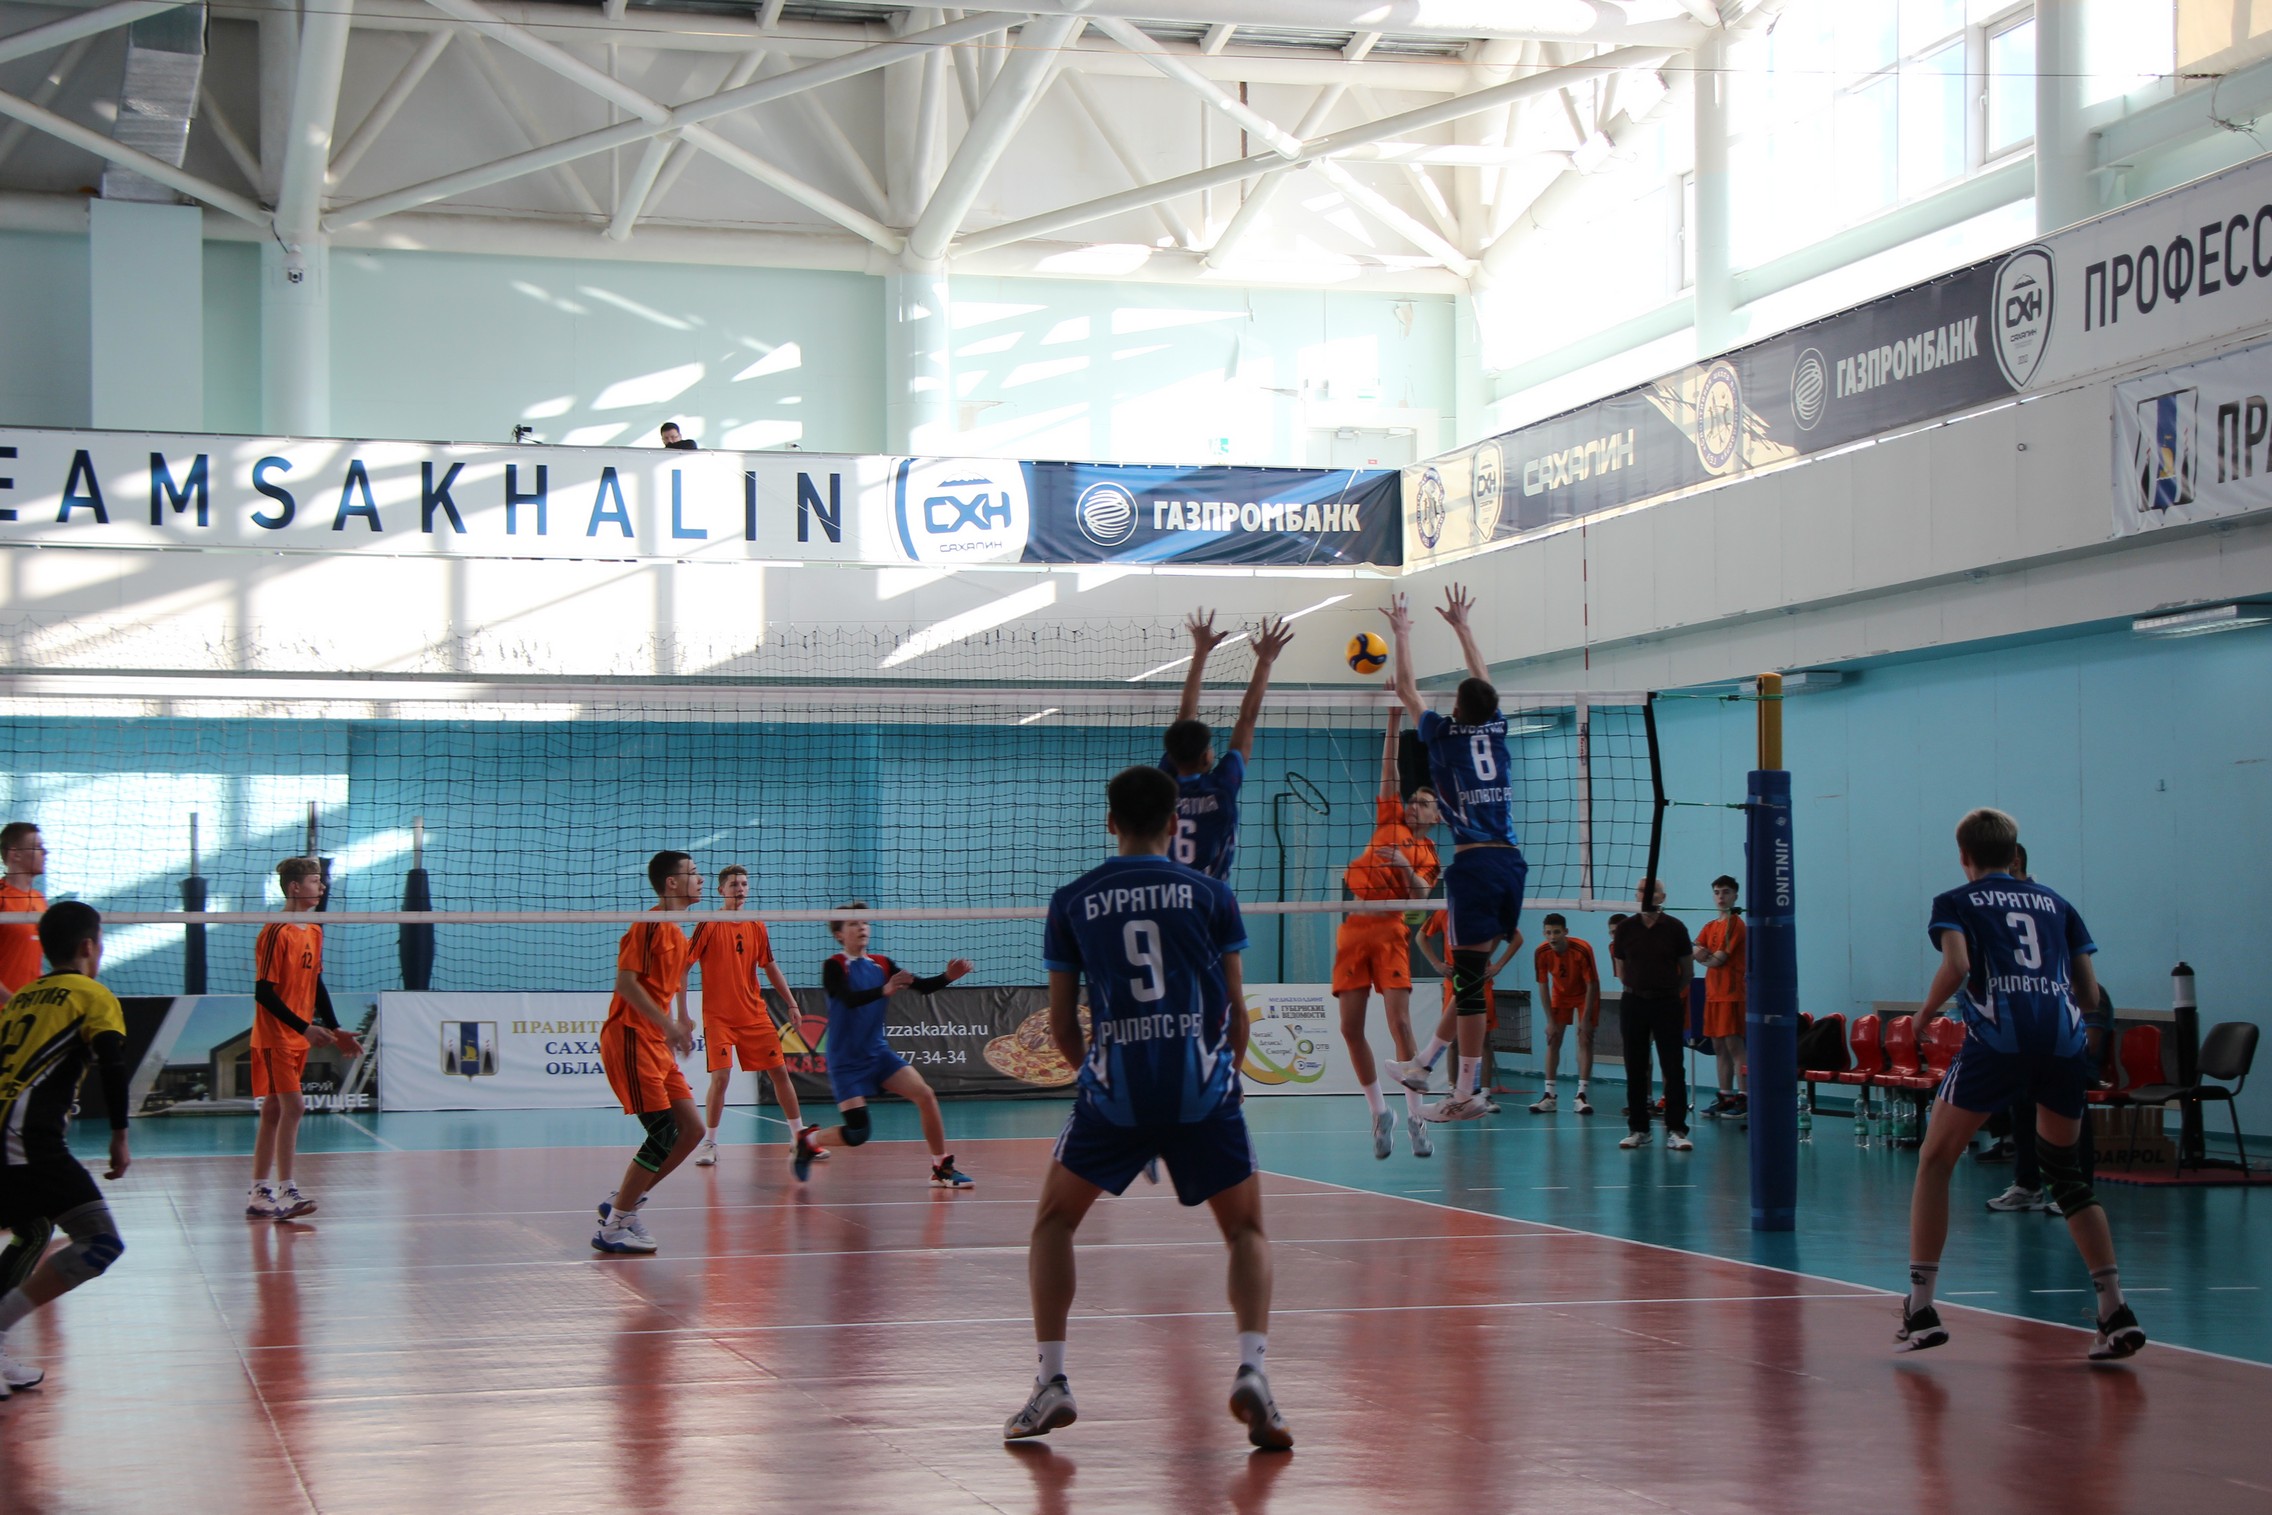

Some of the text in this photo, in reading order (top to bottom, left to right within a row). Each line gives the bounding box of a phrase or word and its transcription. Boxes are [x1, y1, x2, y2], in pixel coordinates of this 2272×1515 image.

[2084, 204, 2272, 332] ПРОФЕСС
[1836, 315, 1979, 399] ГАЗПРОМБАНК
[2217, 395, 2272, 484] ПР
[1153, 500, 1361, 534] ГАЗПРОМБАНК
[1470, 734, 1497, 781] 8
[1458, 788, 1502, 806] РЦПВТС
[1174, 819, 1197, 864] 6
[1776, 838, 1789, 908] JINLING
[1084, 883, 1194, 922] БУРЯТИЯ
[1968, 890, 2057, 914] БУРЯТИЯ
[735, 940, 744, 955] 4
[2005, 911, 2042, 970] 3
[301, 951, 312, 969] 12
[1123, 919, 1166, 1002] 9
[1989, 975, 2048, 994] РЦПВТС
[512, 1019, 600, 1035] ПРАВИТ
[882, 1021, 989, 1037] izzaskazka.ru
[1102, 1011, 1203, 1046] РЦПВТС РБ
[545, 1040, 601, 1055] САХА
[546, 1061, 606, 1076] ОБЛА
[785, 1056, 827, 1073] КАЗ
[303, 1080, 333, 1092] ИРУЙ
[254, 1093, 370, 1110] БДУЩЕЕ
